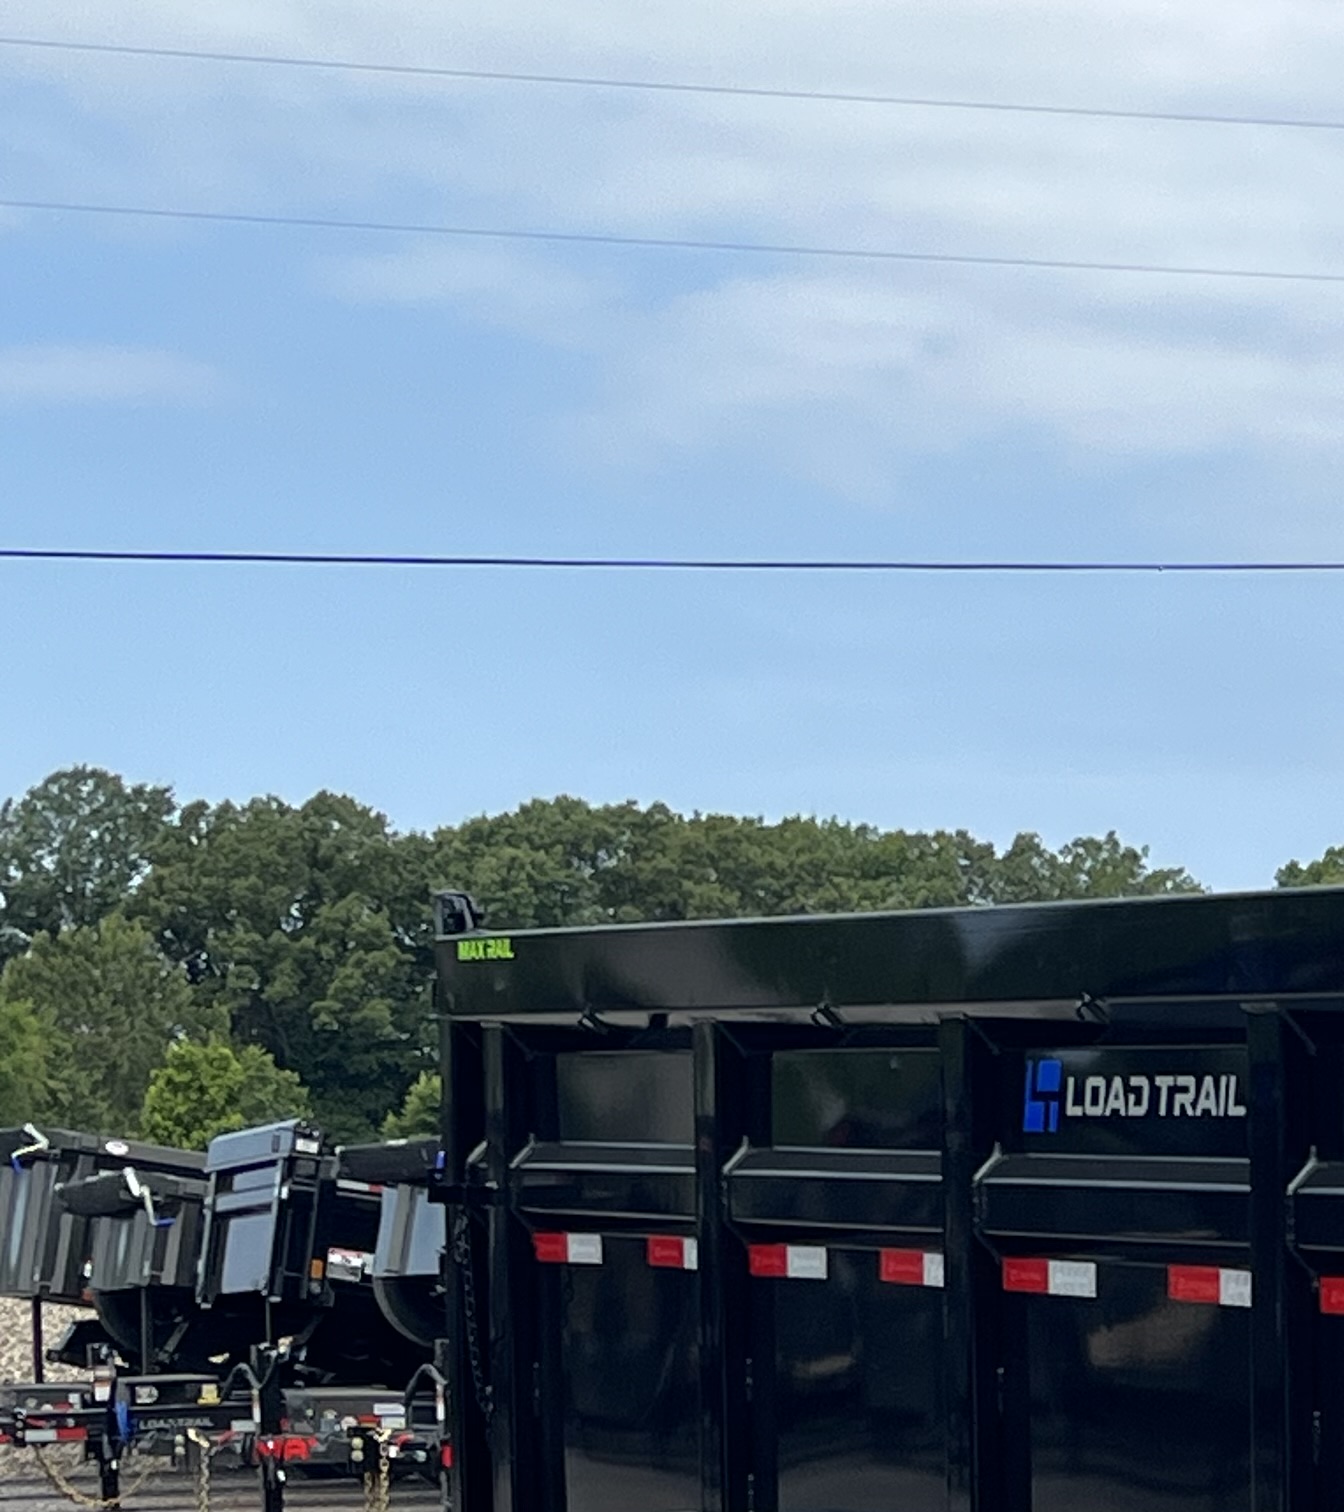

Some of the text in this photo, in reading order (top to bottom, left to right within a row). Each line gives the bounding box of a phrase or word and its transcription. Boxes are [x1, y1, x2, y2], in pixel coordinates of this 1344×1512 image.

[457, 938, 515, 960] MAX RAIL
[1066, 1074, 1248, 1117] LOAD TRAIL
